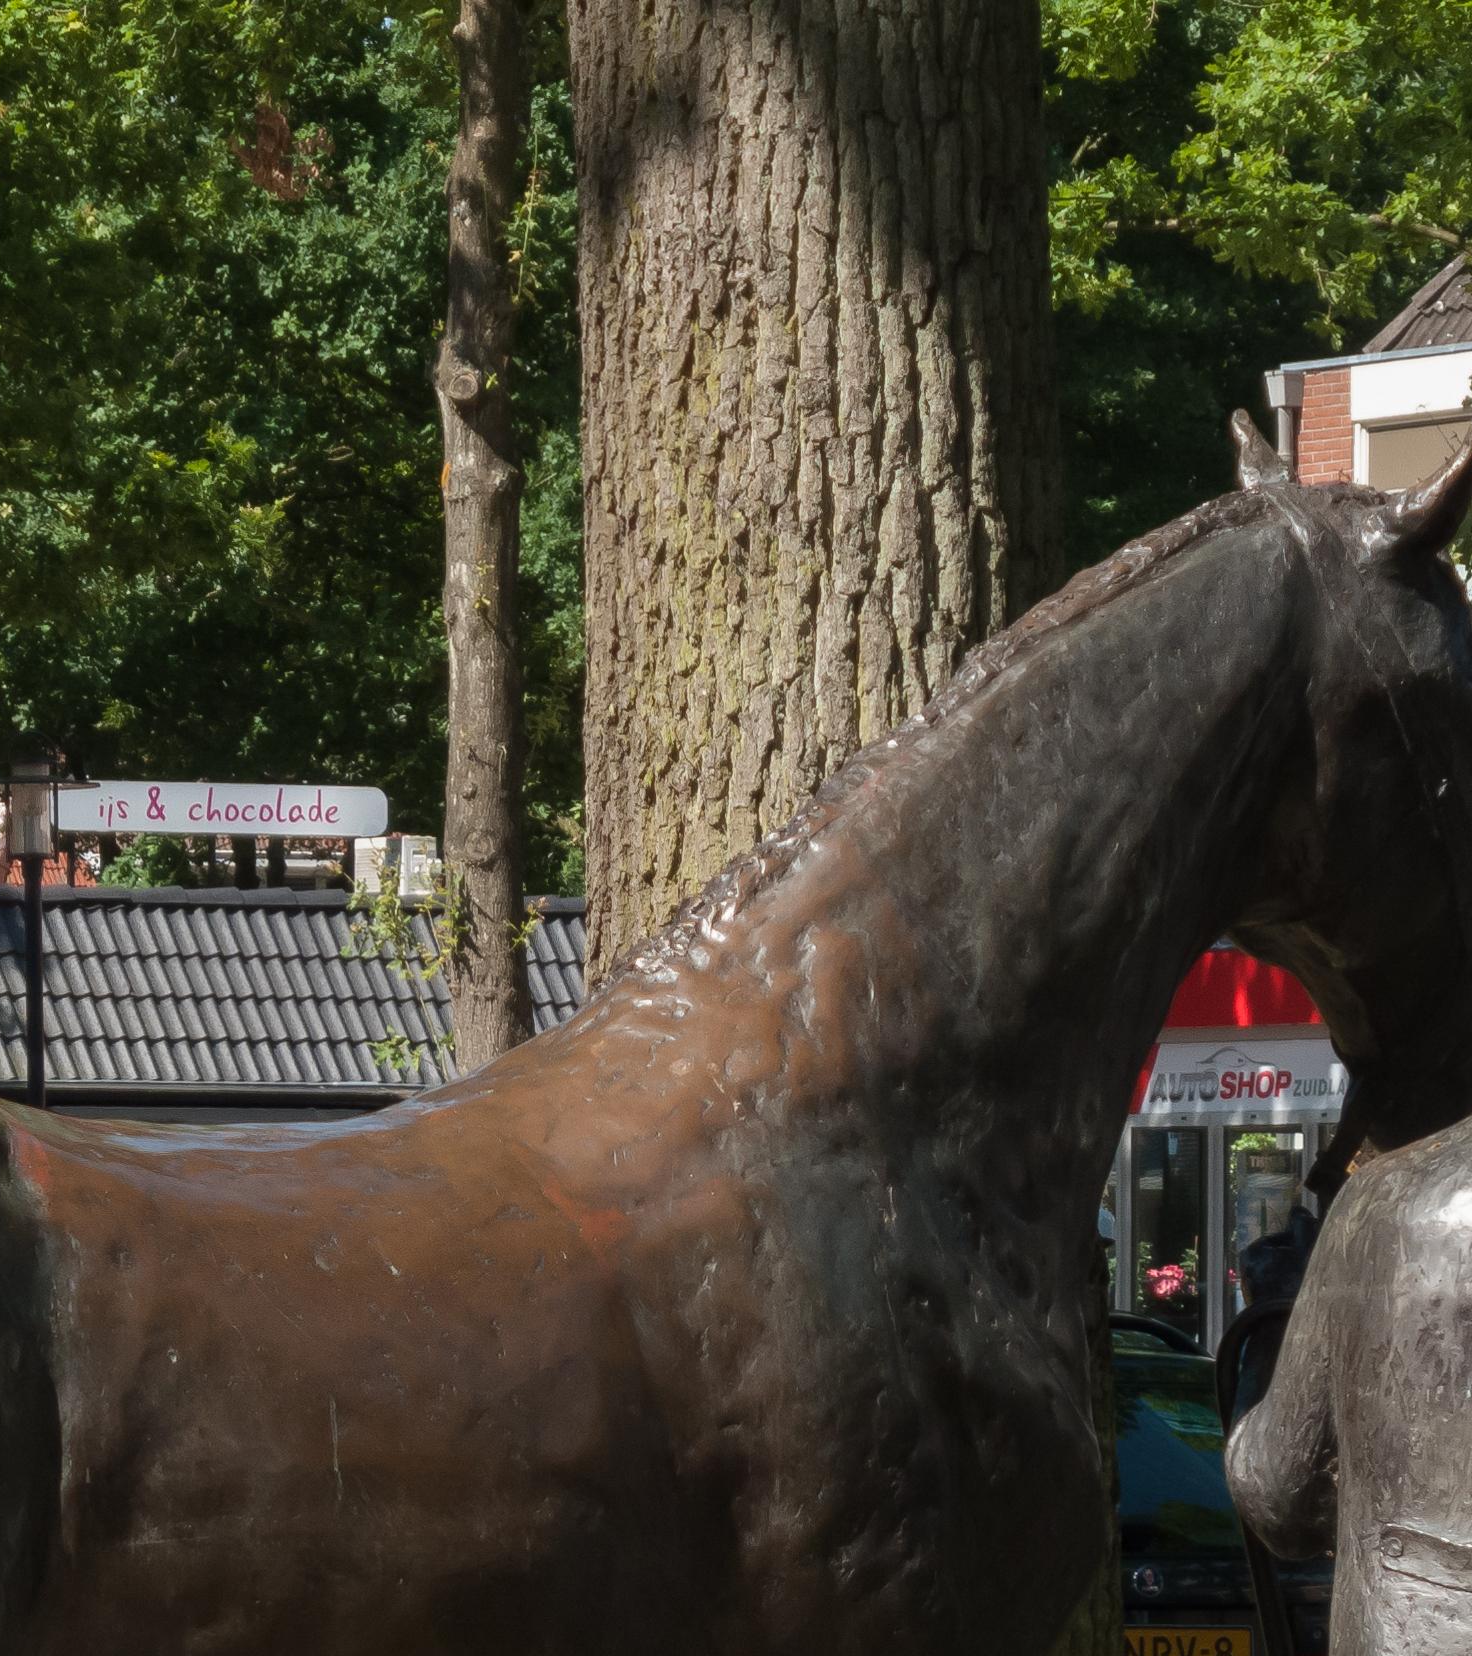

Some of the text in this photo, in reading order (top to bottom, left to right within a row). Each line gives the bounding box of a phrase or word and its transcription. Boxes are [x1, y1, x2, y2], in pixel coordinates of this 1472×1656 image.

[98, 785, 341, 827] ijs & chocolade
[1293, 1078, 1346, 1098] ZUIDLA
